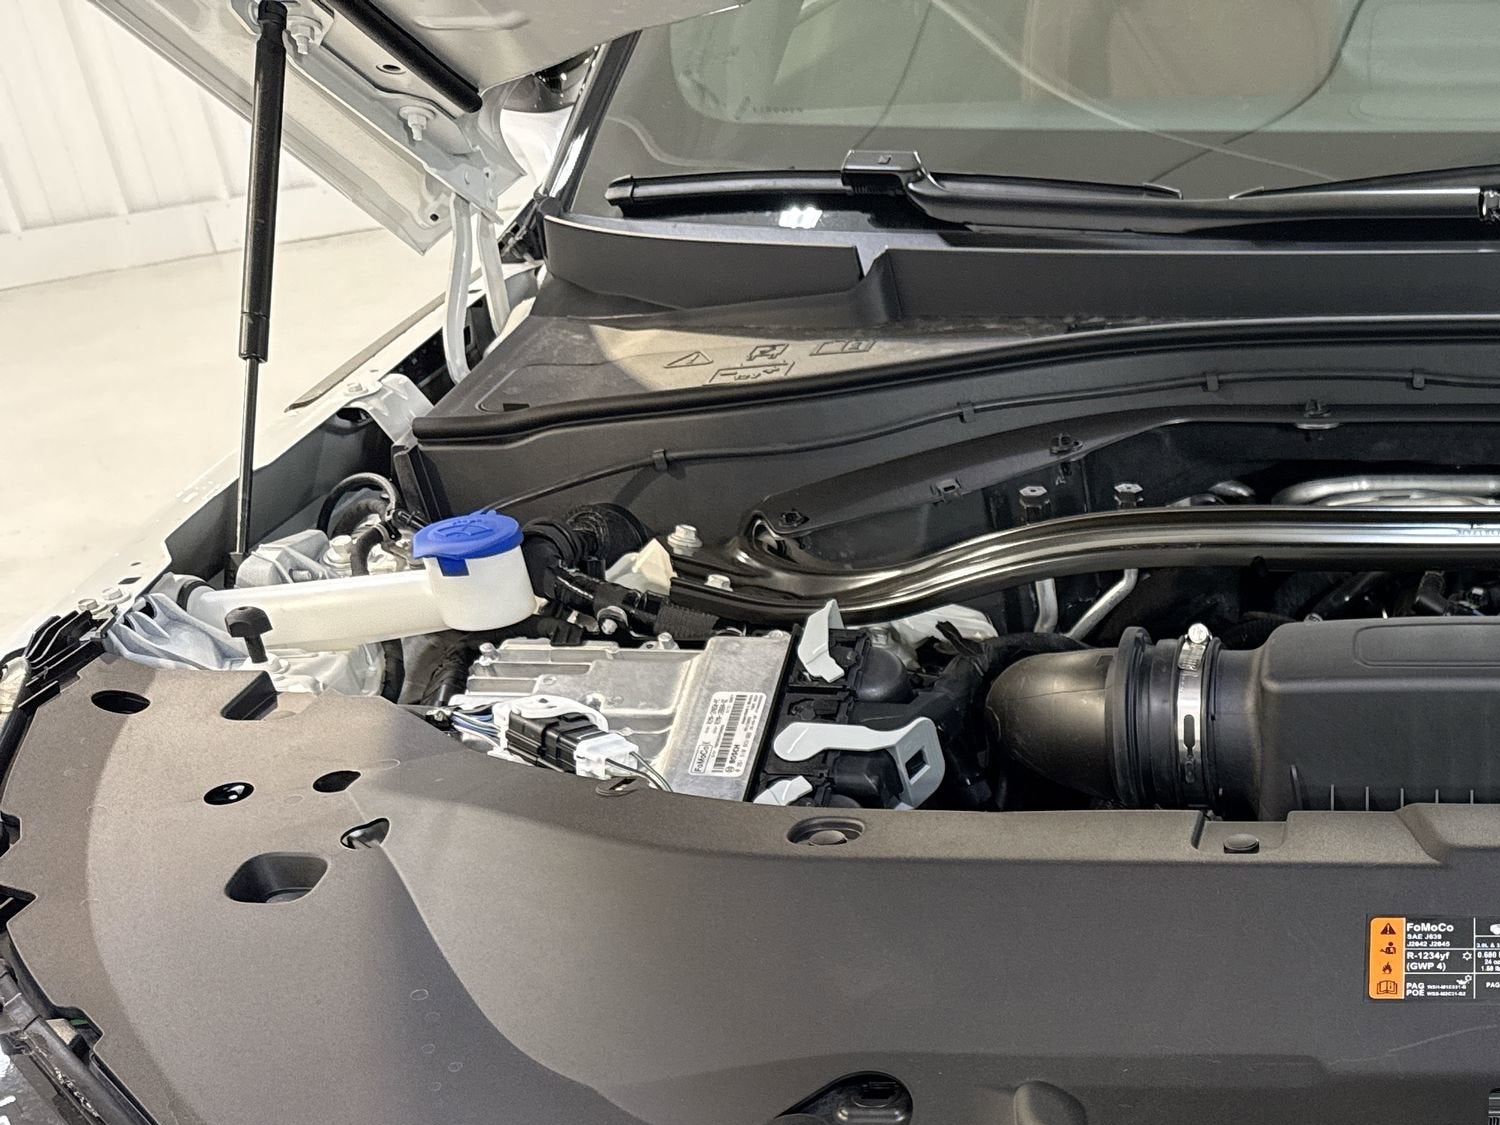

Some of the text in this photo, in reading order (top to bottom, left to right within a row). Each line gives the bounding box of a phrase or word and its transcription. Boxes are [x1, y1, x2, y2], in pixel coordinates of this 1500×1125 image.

[694, 747, 709, 772] FoMoCo
[1406, 922, 1454, 932] FoMoCo
[1406, 951, 1450, 961] R-1234yf
[1406, 962, 1446, 971] (GWP 4)
